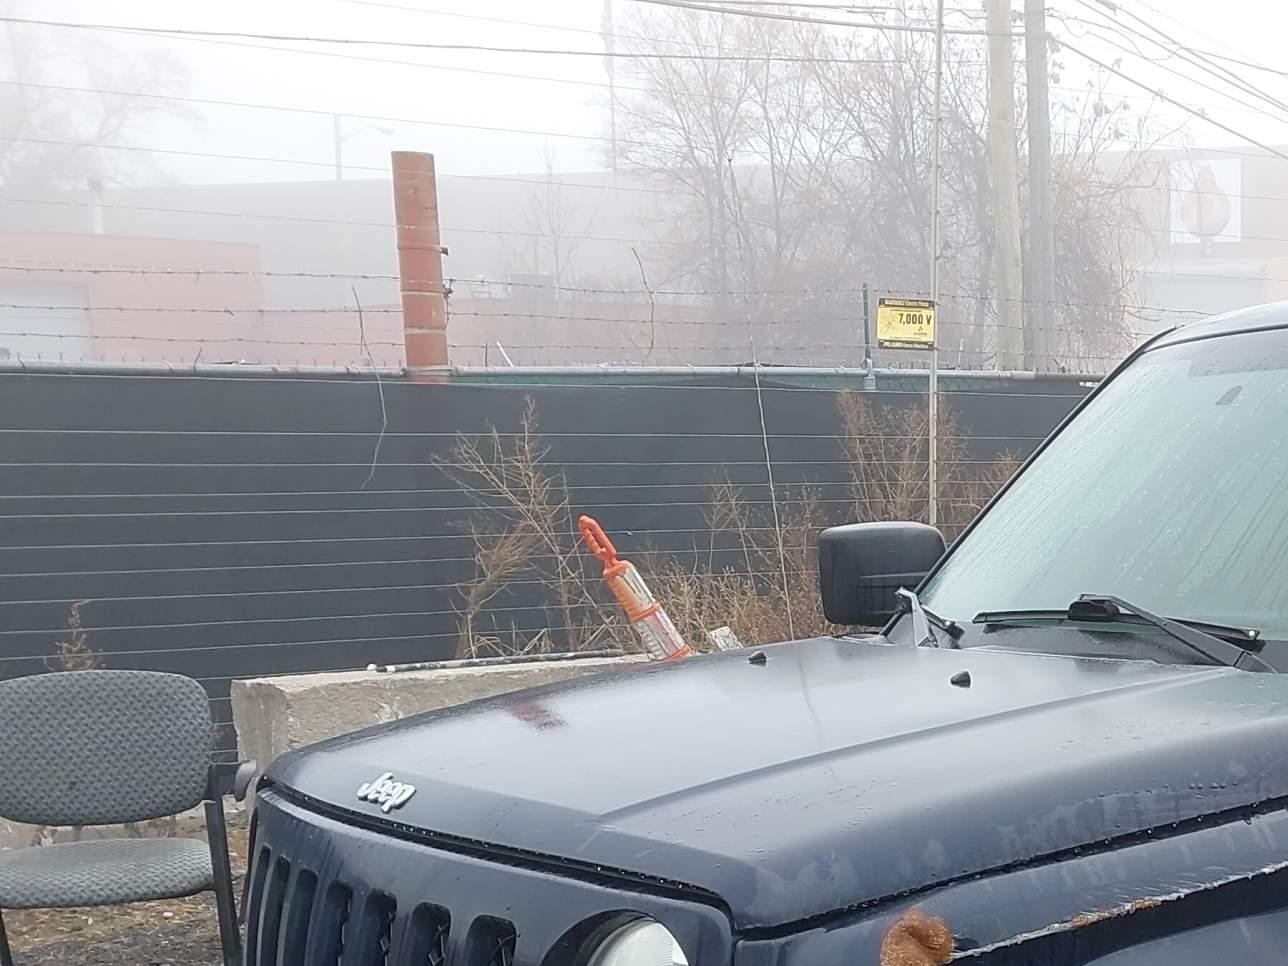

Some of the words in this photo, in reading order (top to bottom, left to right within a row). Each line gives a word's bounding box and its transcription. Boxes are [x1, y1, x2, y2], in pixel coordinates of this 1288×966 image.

[898, 313, 924, 325] 7,000
[926, 314, 932, 325] V
[357, 771, 416, 813] Jeep
